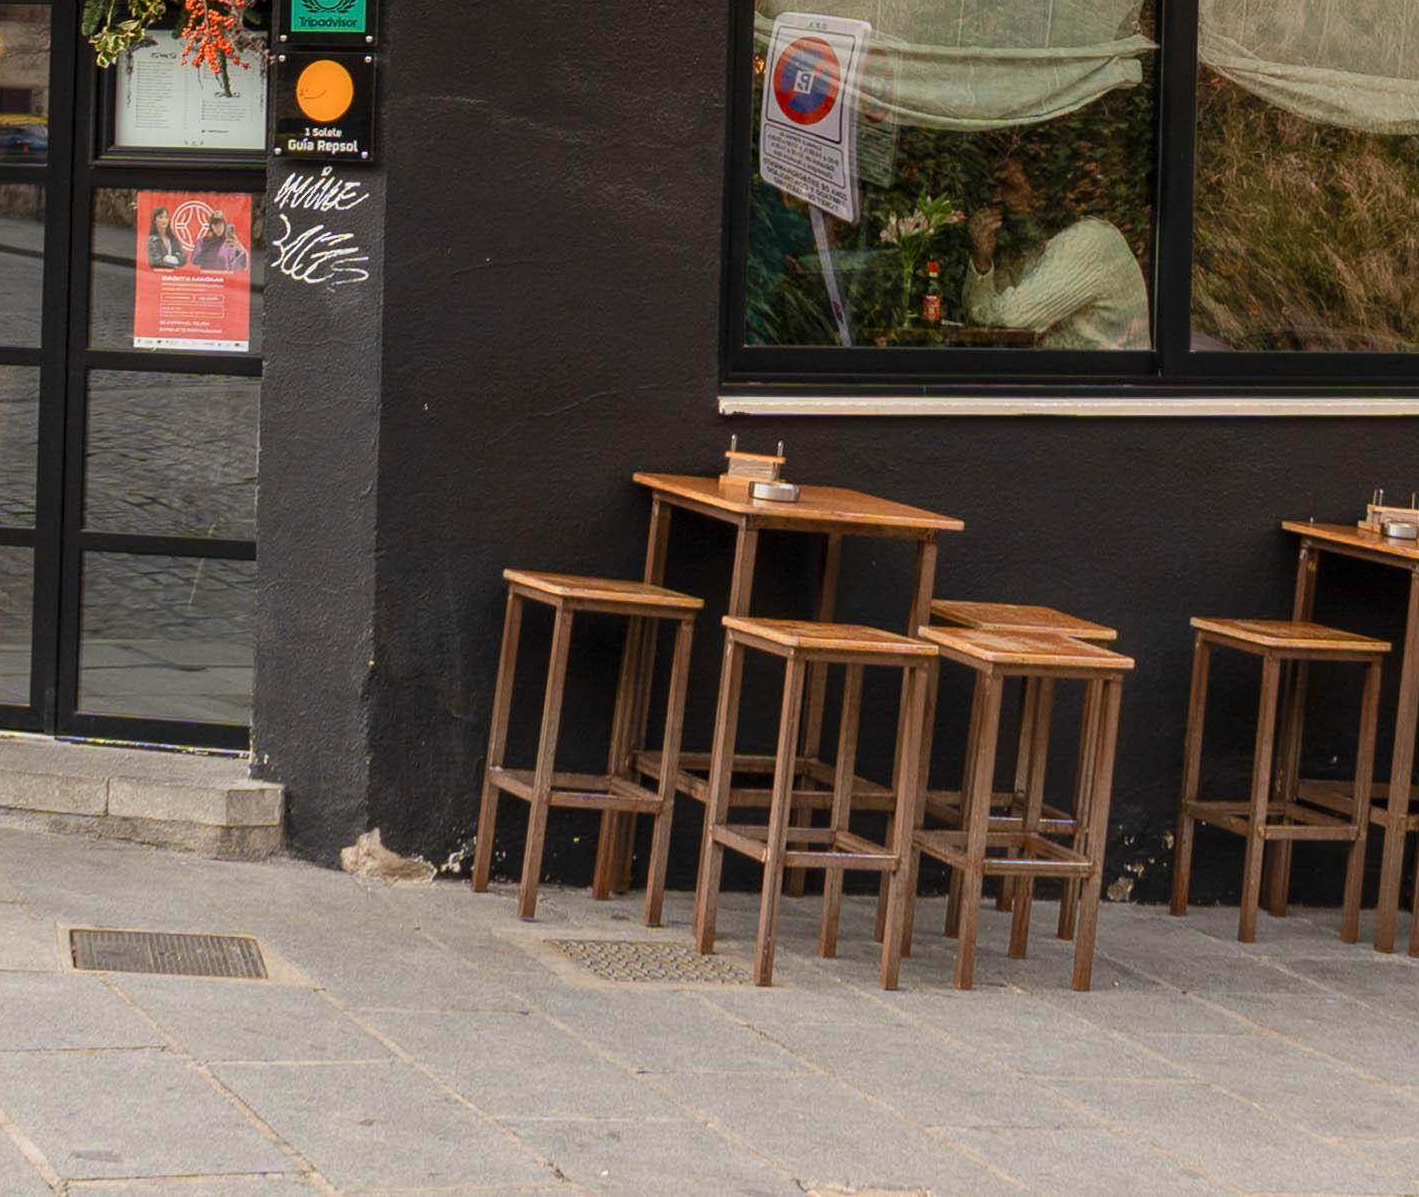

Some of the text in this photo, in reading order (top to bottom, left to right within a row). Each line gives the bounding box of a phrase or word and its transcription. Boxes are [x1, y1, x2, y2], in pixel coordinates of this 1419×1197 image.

[299, 16, 357, 28] Tripadvisor
[287, 138, 359, 154] Guía Repsol
